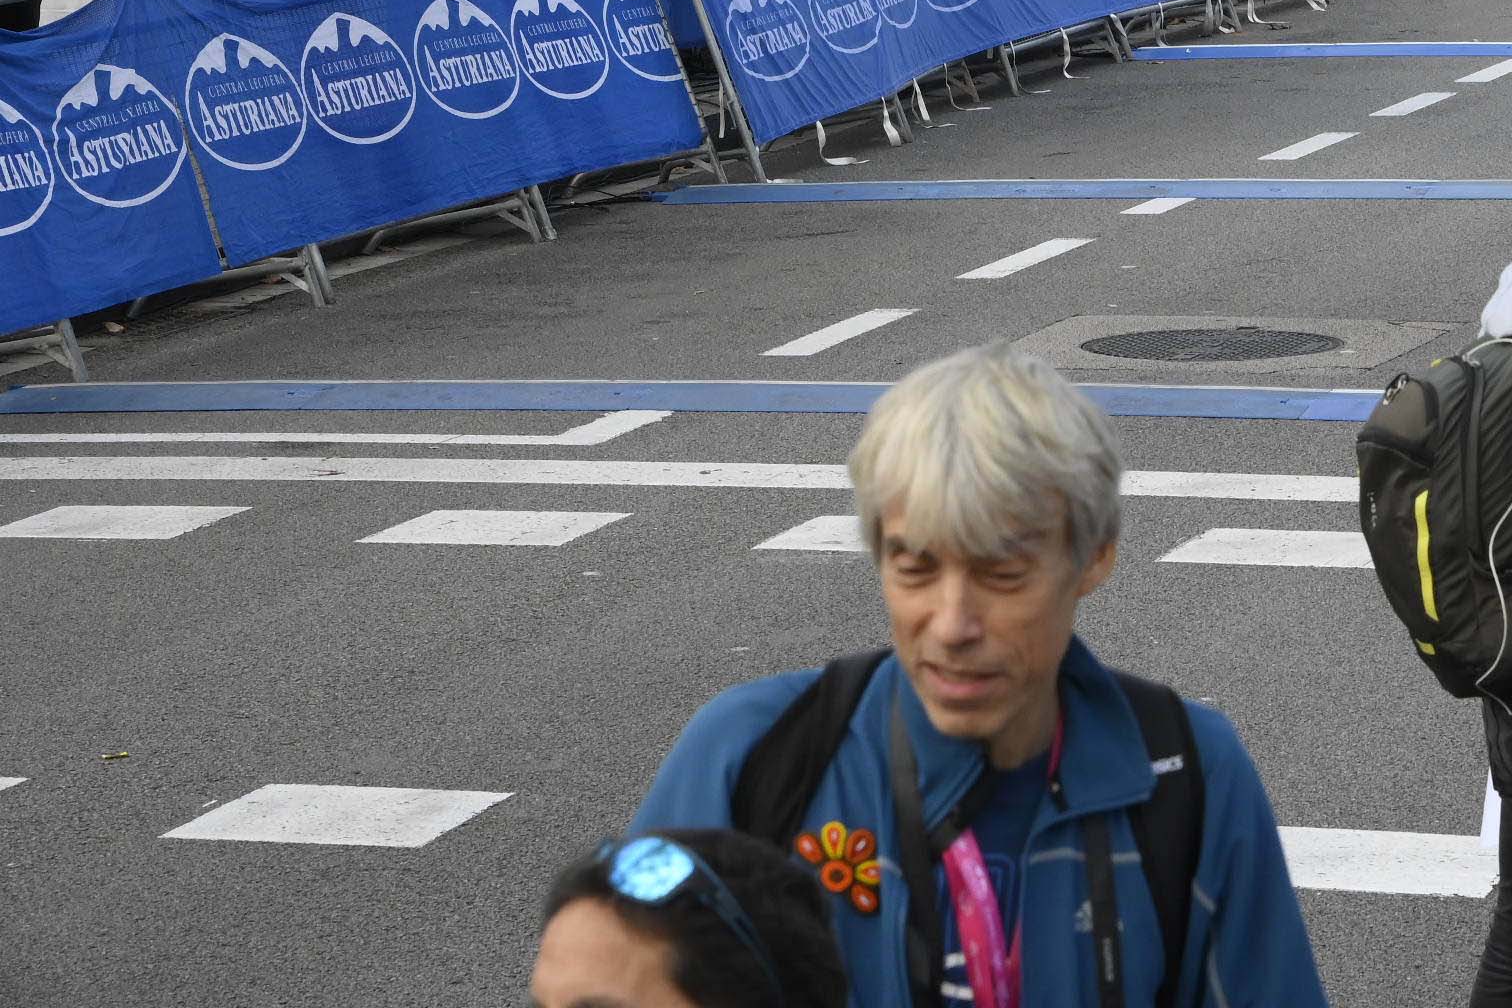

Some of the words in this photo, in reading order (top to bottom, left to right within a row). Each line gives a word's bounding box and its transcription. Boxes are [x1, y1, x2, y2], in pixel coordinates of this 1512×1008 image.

[433, 37, 469, 52] CENTRAL
[471, 30, 500, 47] LECHERA
[527, 23, 556, 37] CENTRAL
[557, 17, 588, 33] LECHERA
[613, 14, 674, 58] ASTUR
[321, 58, 358, 75] CENTRAL
[359, 50, 396, 67] LECHERA
[424, 44, 516, 93] ASTURIANA
[520, 29, 605, 75] ASTURIANA
[208, 82, 248, 98] CENTRAL
[250, 73, 286, 90] LECHERA
[311, 67, 412, 118] ASTURIANA
[197, 90, 301, 143] ASTURIANA
